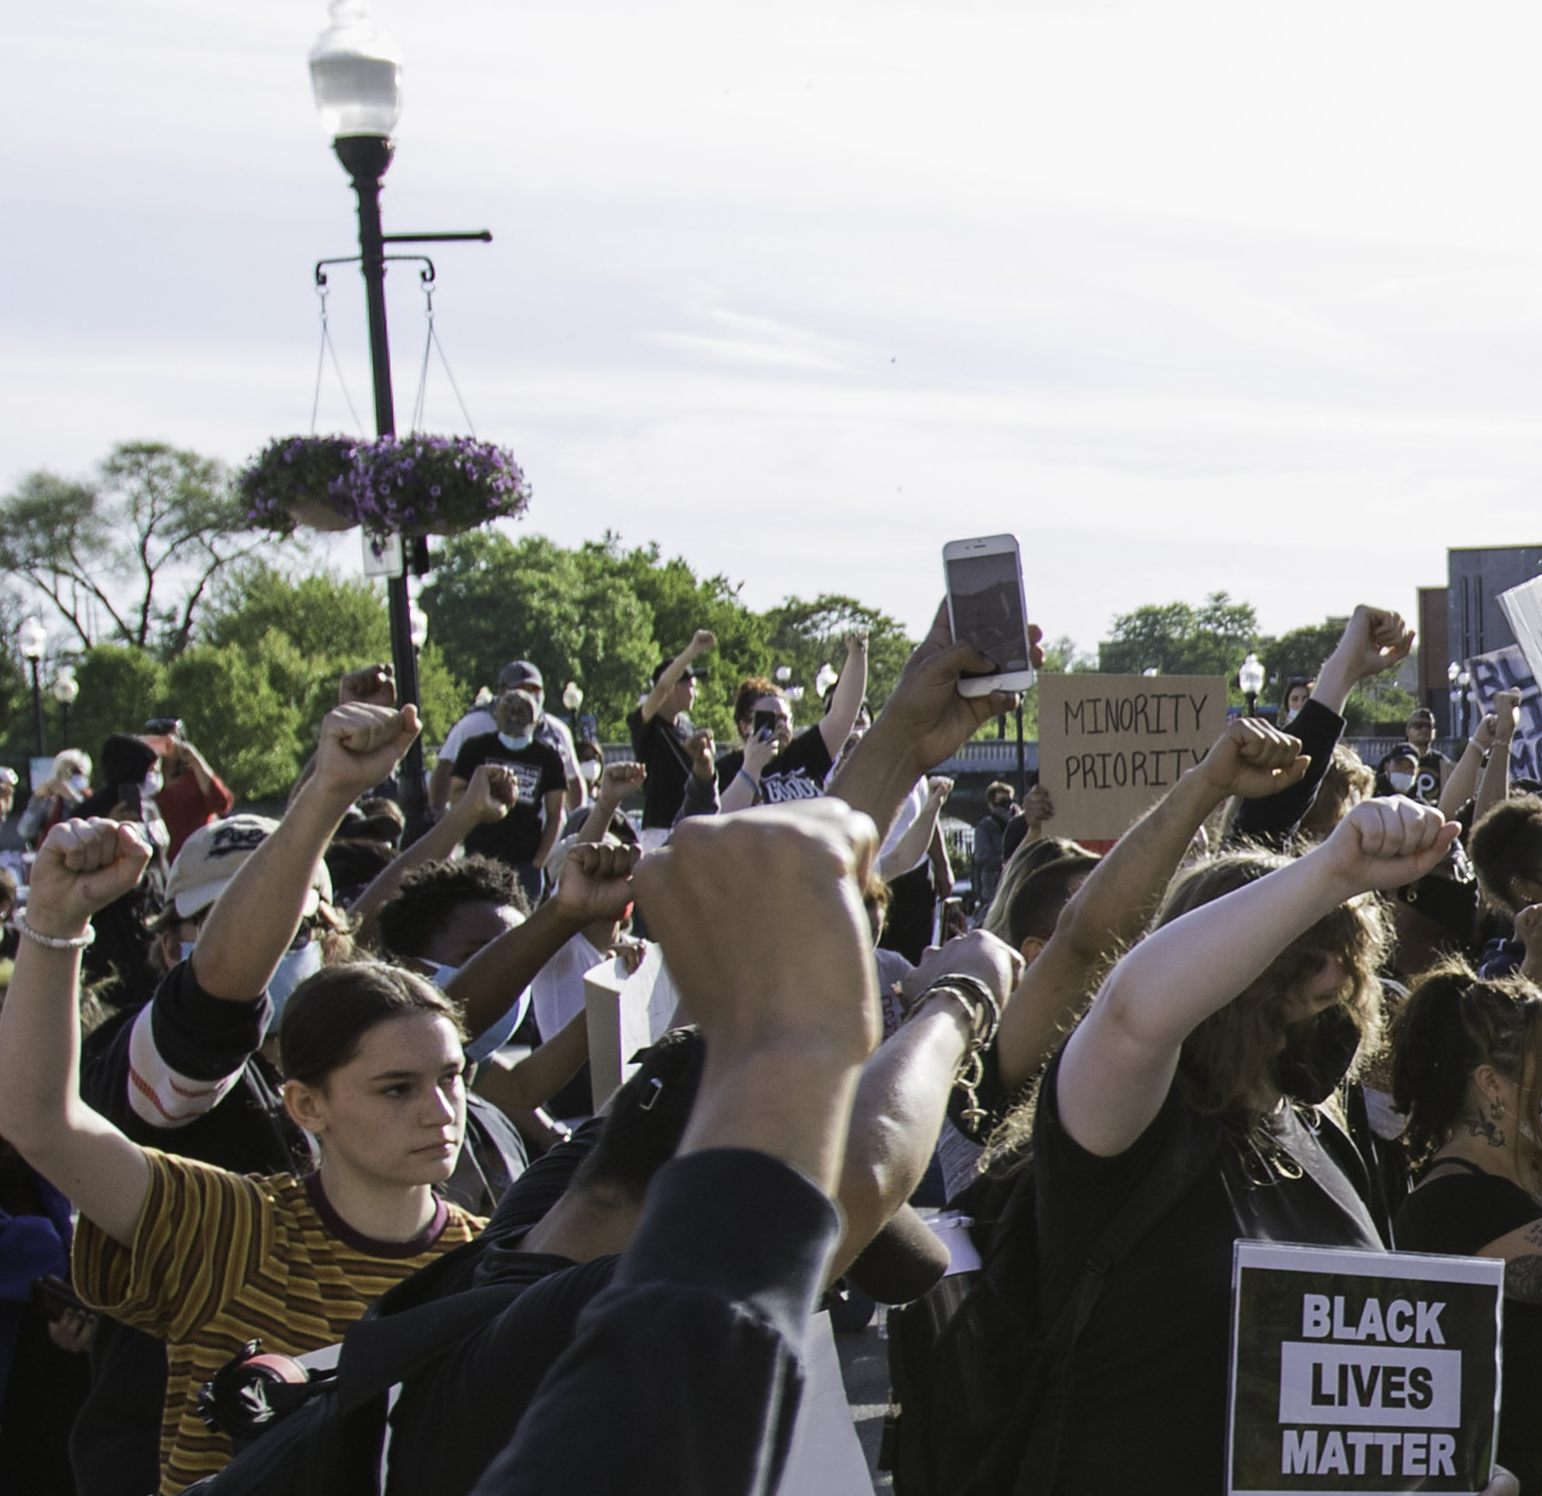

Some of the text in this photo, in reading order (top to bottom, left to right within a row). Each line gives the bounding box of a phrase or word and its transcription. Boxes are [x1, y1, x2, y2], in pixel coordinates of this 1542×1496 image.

[1064, 693, 1208, 737] MINORITY
[1303, 1294, 1446, 1344] BLACK
[1311, 1362, 1434, 1409] LIVES
[1281, 1430, 1457, 1478] MATTER
